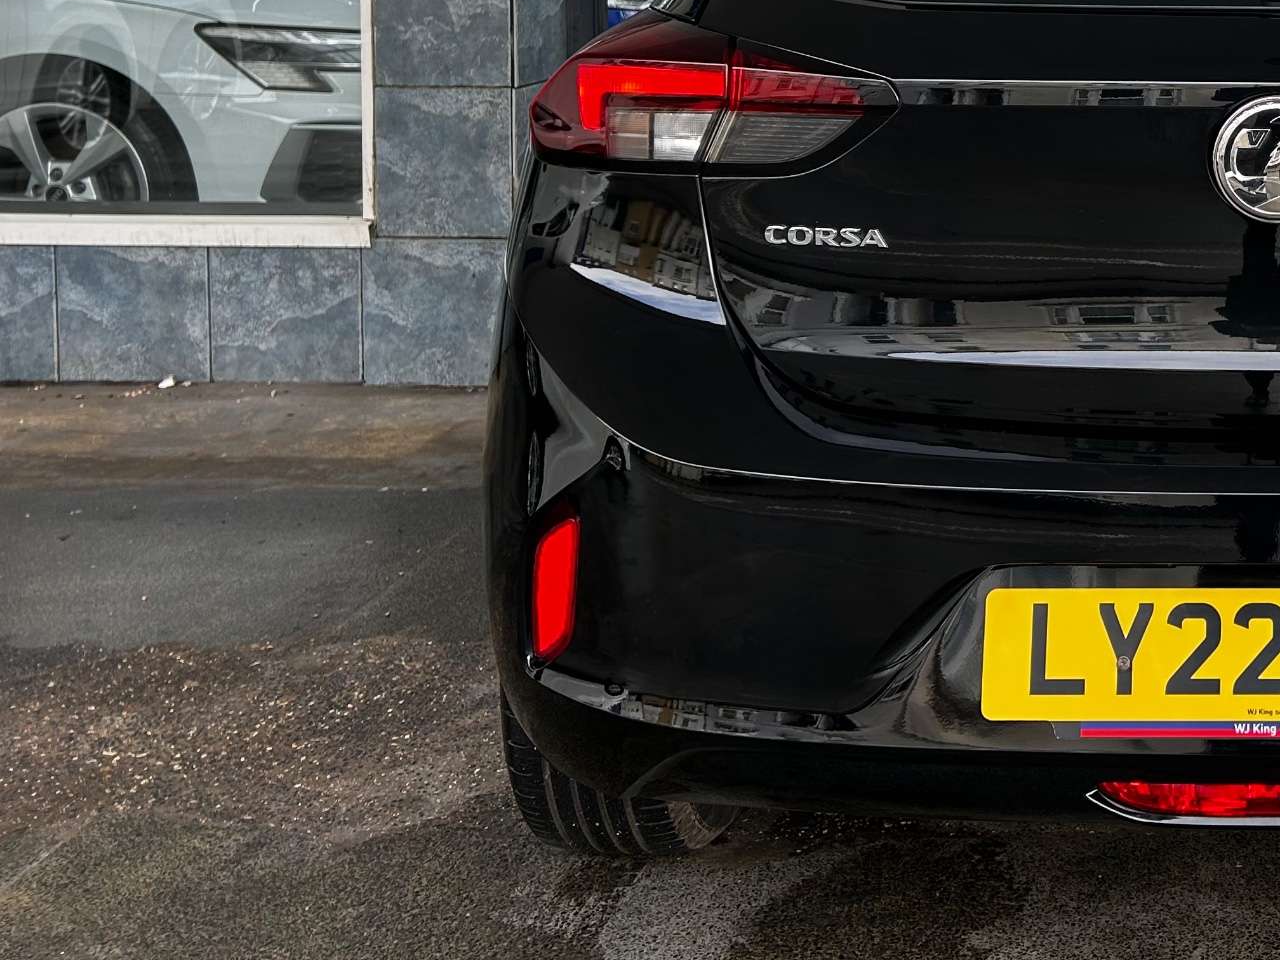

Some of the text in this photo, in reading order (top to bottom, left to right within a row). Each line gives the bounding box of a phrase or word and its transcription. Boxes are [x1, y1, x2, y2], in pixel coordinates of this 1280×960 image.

[764, 225, 889, 249] CORSA
[1258, 708, 1273, 716] King
[1234, 723, 1250, 734] WJ
[1252, 723, 1277, 737] King
